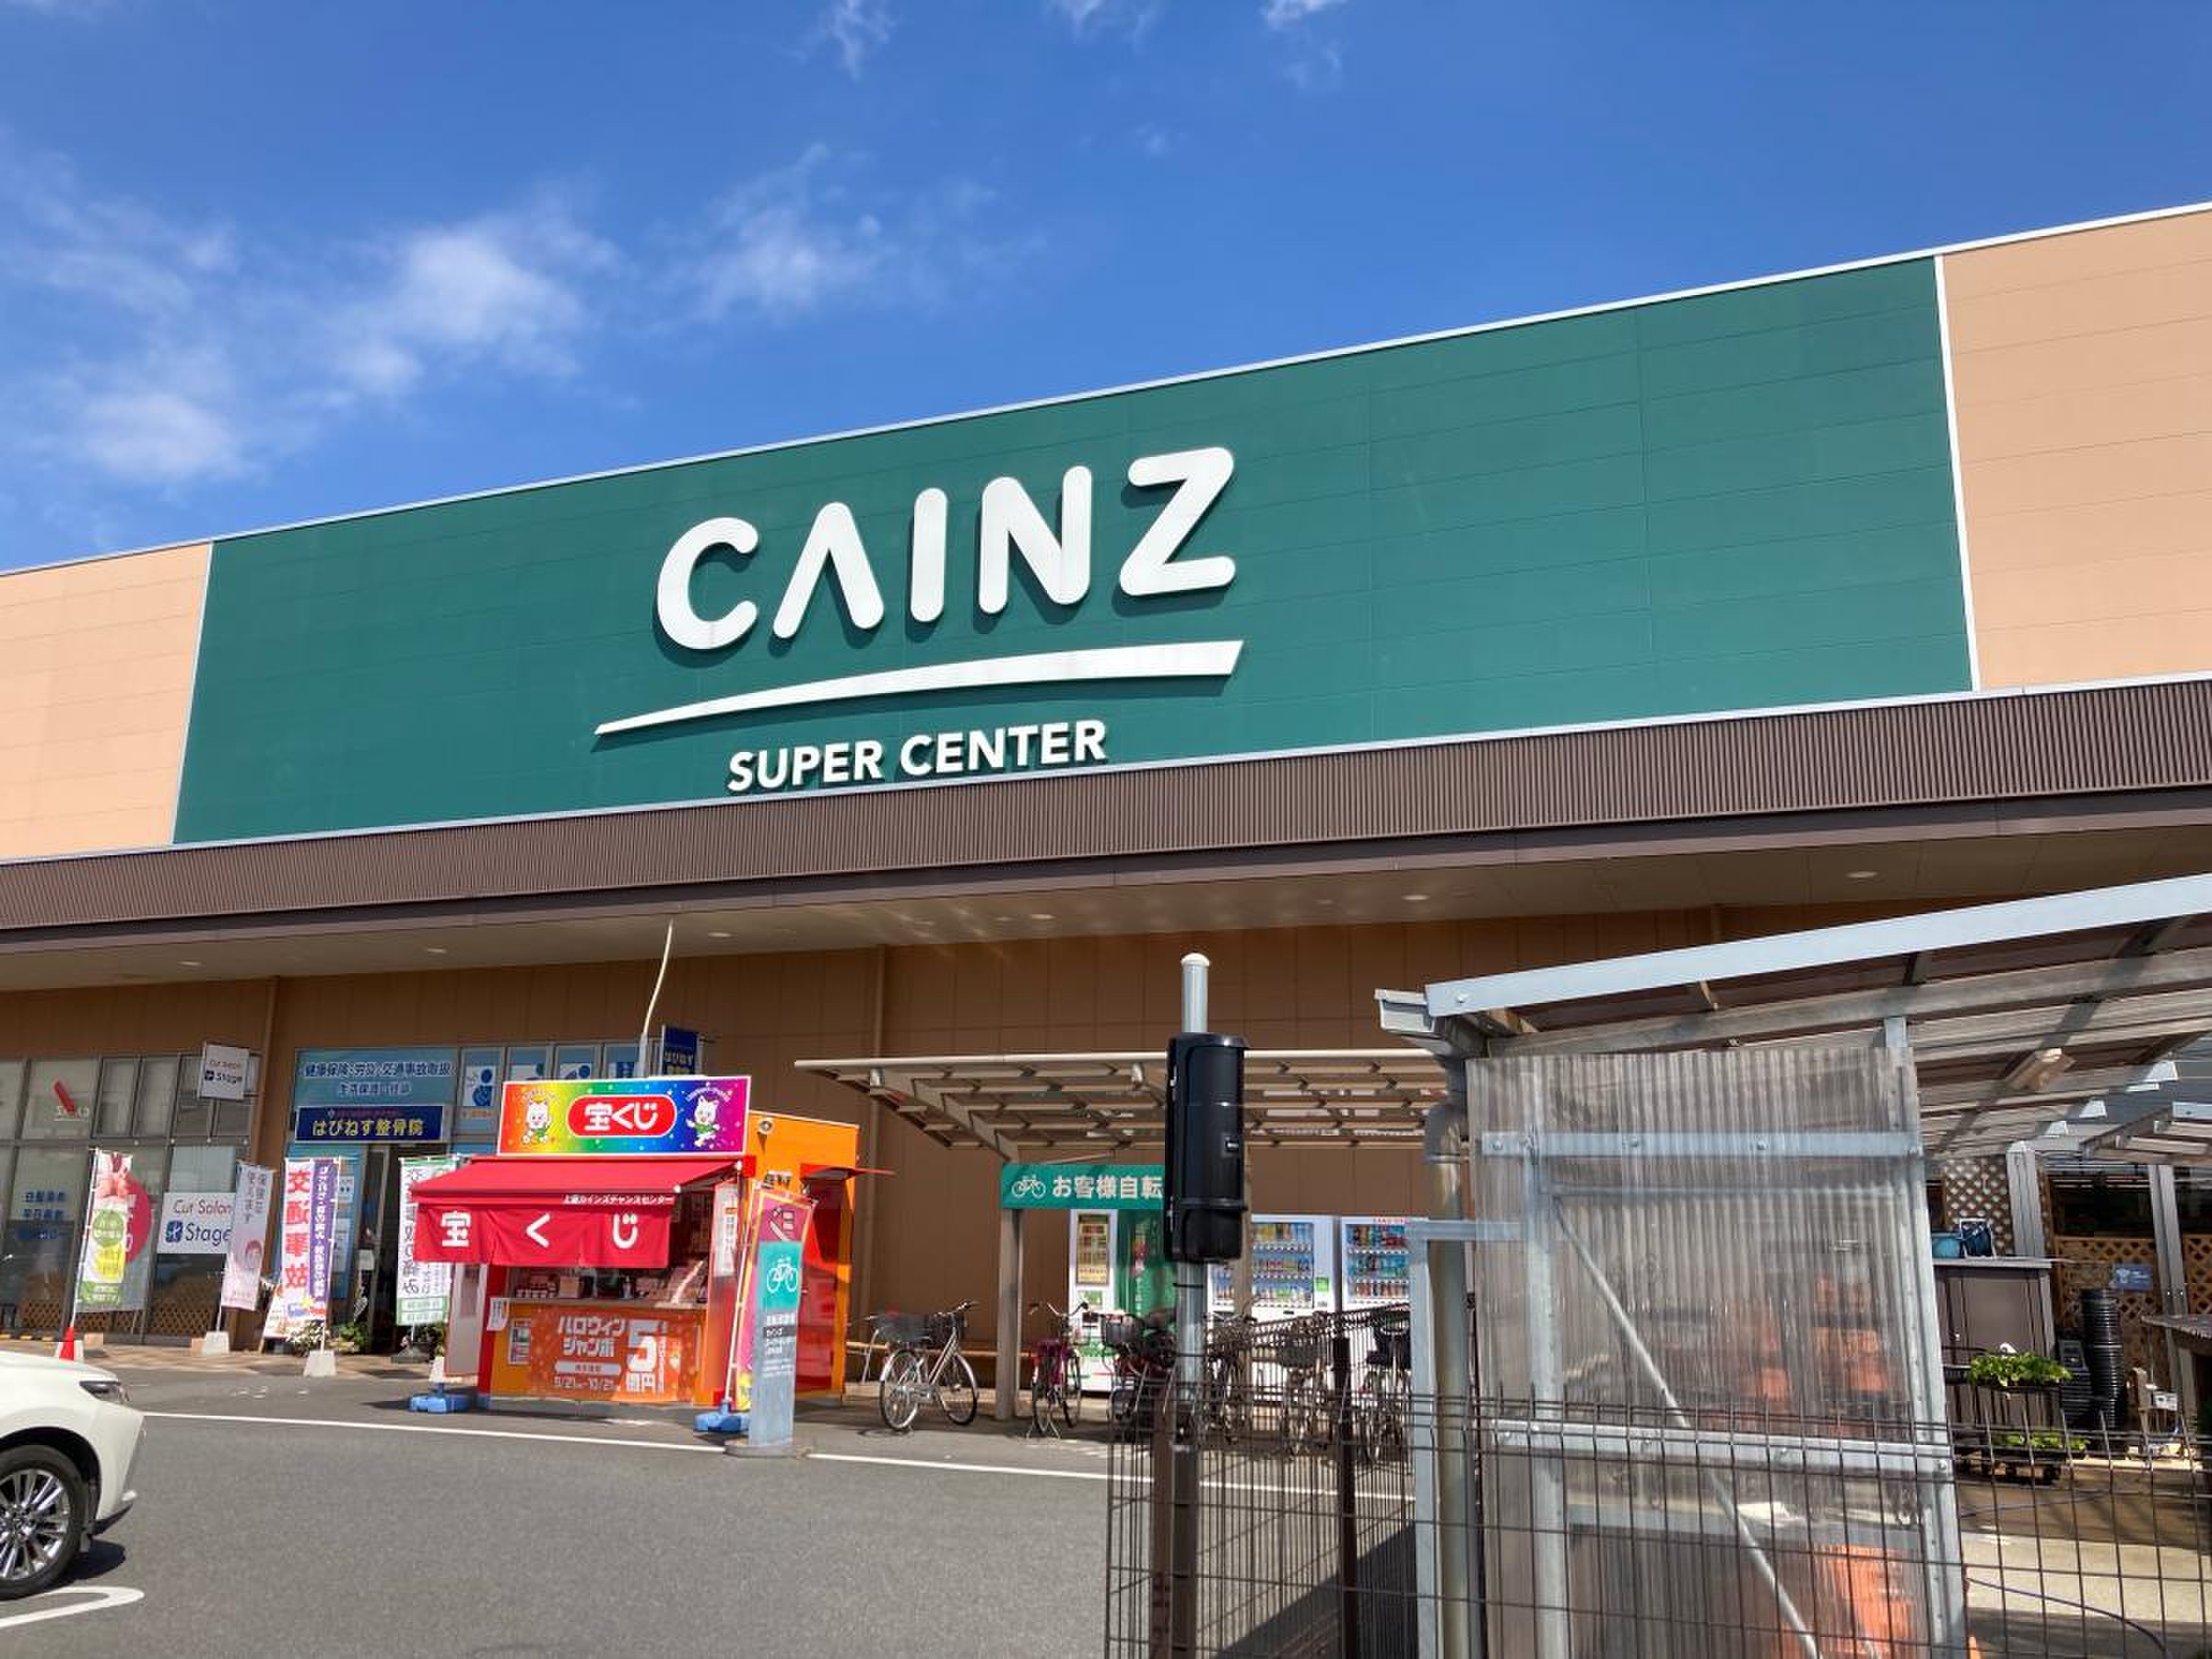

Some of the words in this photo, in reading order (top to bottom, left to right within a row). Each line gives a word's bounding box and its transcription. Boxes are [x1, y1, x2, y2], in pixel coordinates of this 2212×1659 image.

[657, 447, 1236, 649] CAINZ
[727, 740, 884, 792] SUPER
[900, 720, 1106, 776] CENTER
[584, 1101, 659, 1131] 宝くじ
[1052, 1175, 1164, 1199] お客様自転
[173, 1199, 194, 1215] Cut
[198, 1199, 234, 1215] Salon
[185, 1221, 232, 1246] Stage
[557, 1315, 626, 1336] ハロウィン
[562, 1335, 615, 1358] ジャンボ
[626, 1319, 658, 1372] 5
